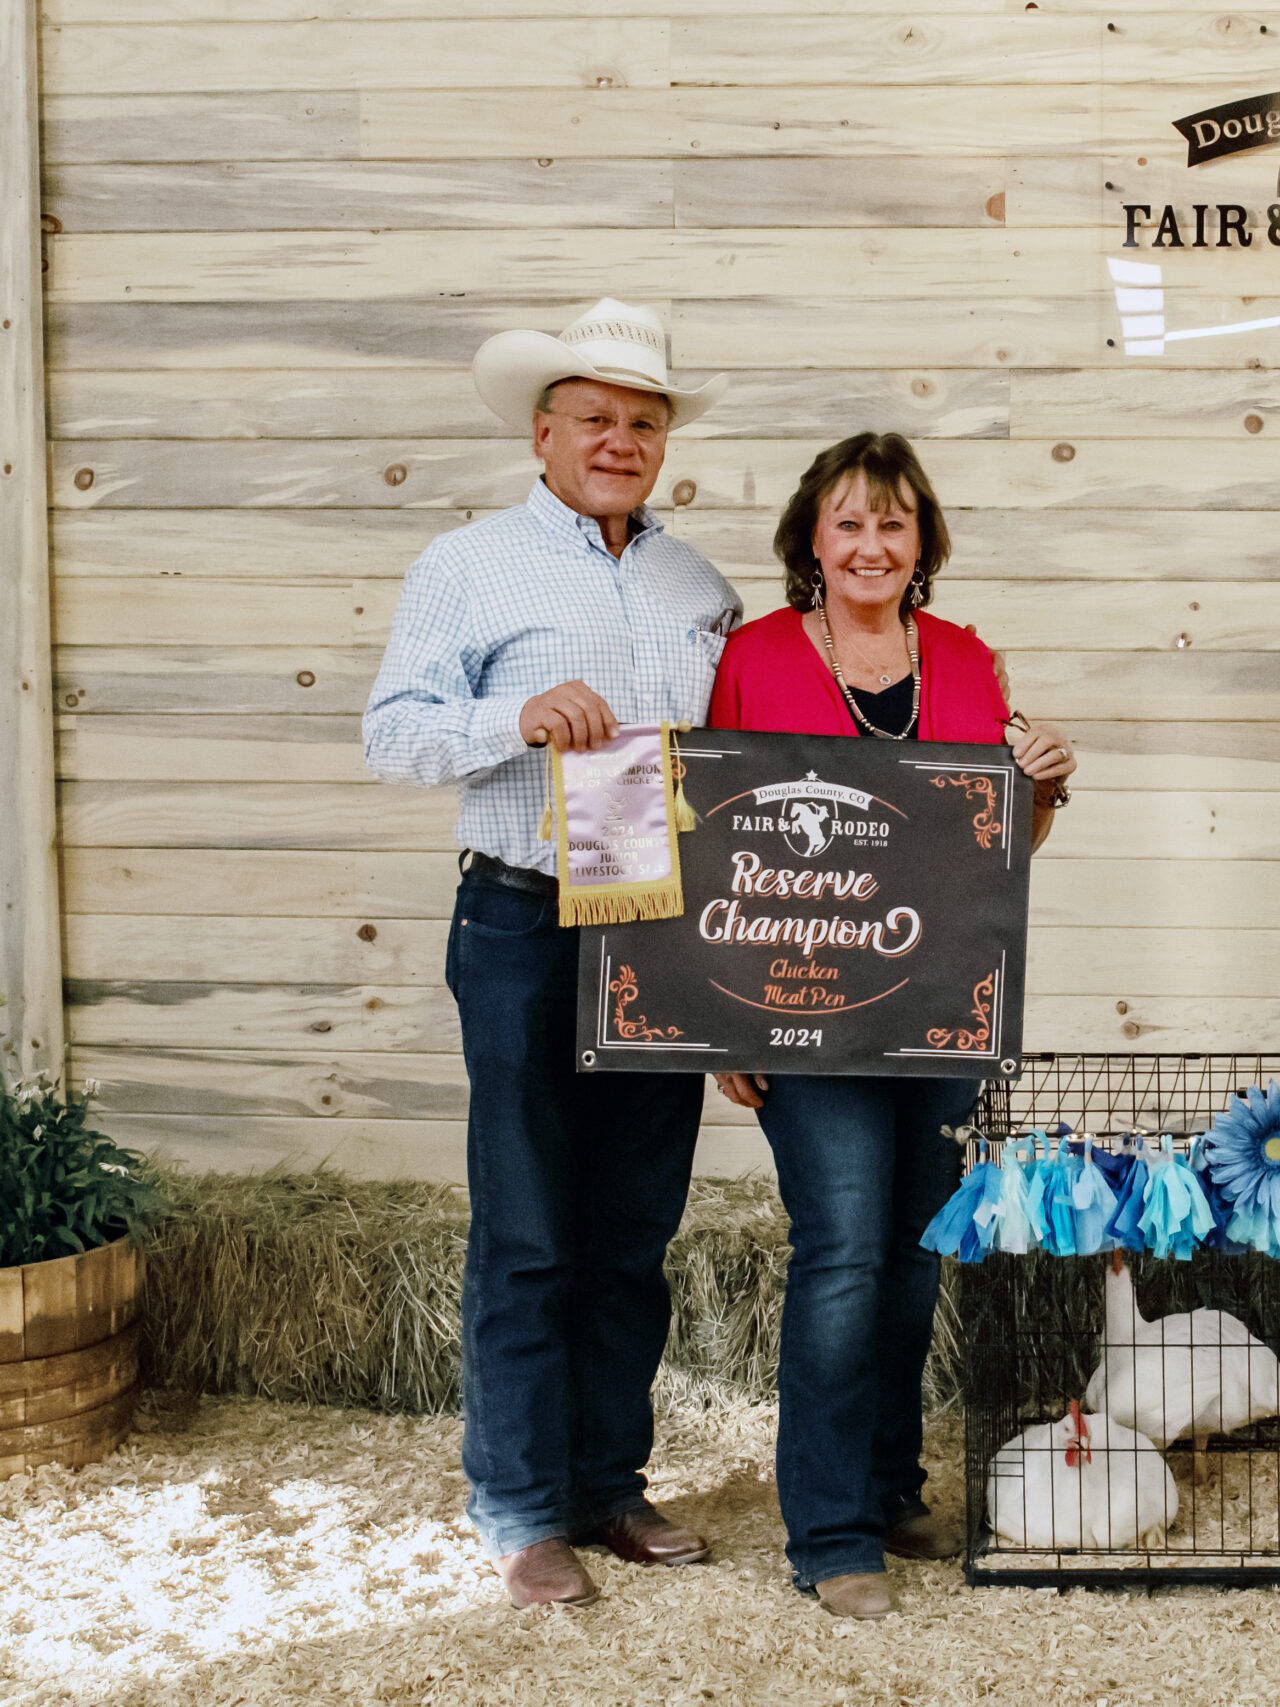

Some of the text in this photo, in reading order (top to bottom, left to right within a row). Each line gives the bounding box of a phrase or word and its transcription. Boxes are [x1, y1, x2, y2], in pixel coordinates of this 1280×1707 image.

[1122, 203, 1253, 248] FAIR
[759, 785, 801, 799] Douglas
[849, 792, 865, 805] CO
[601, 824, 634, 837] 2024
[732, 815, 890, 837] FAIR & RODEO
[871, 839, 888, 847] 1918
[731, 851, 879, 900] Reserve
[699, 899, 922, 958] Champion
[769, 959, 839, 980] Chicken
[764, 984, 845, 1006] Meat Pen
[769, 1028, 823, 1047] 2024
